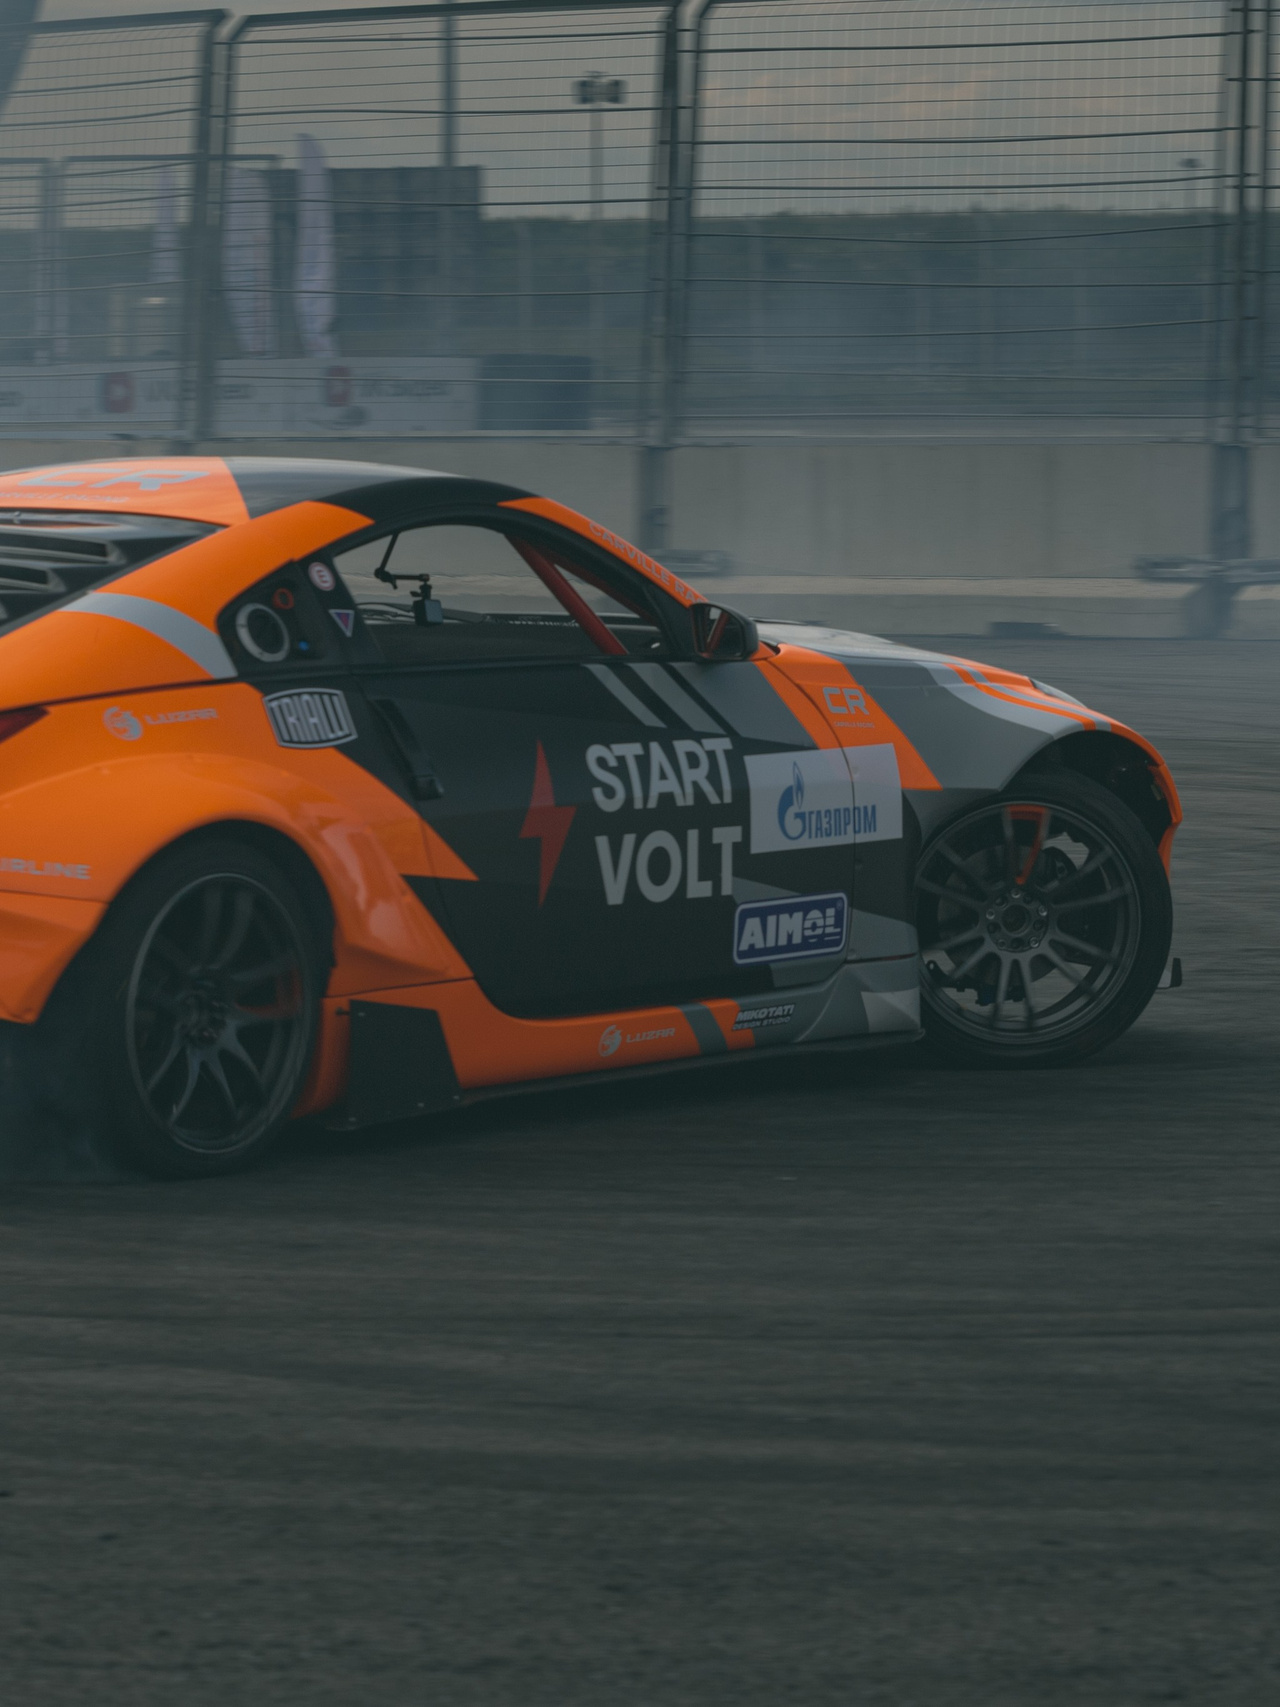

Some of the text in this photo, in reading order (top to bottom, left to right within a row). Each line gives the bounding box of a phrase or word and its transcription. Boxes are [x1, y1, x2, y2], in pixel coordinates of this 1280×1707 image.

[588, 522, 671, 585] CARVILLE
[822, 686, 870, 716] CR
[585, 737, 734, 813] START
[807, 803, 878, 840] ГАЗПРОМ
[594, 826, 742, 906] VOLT
[738, 907, 842, 952] AIMOL
[735, 1004, 795, 1022] MIKOTATI
[625, 1027, 676, 1044] LUZAR
